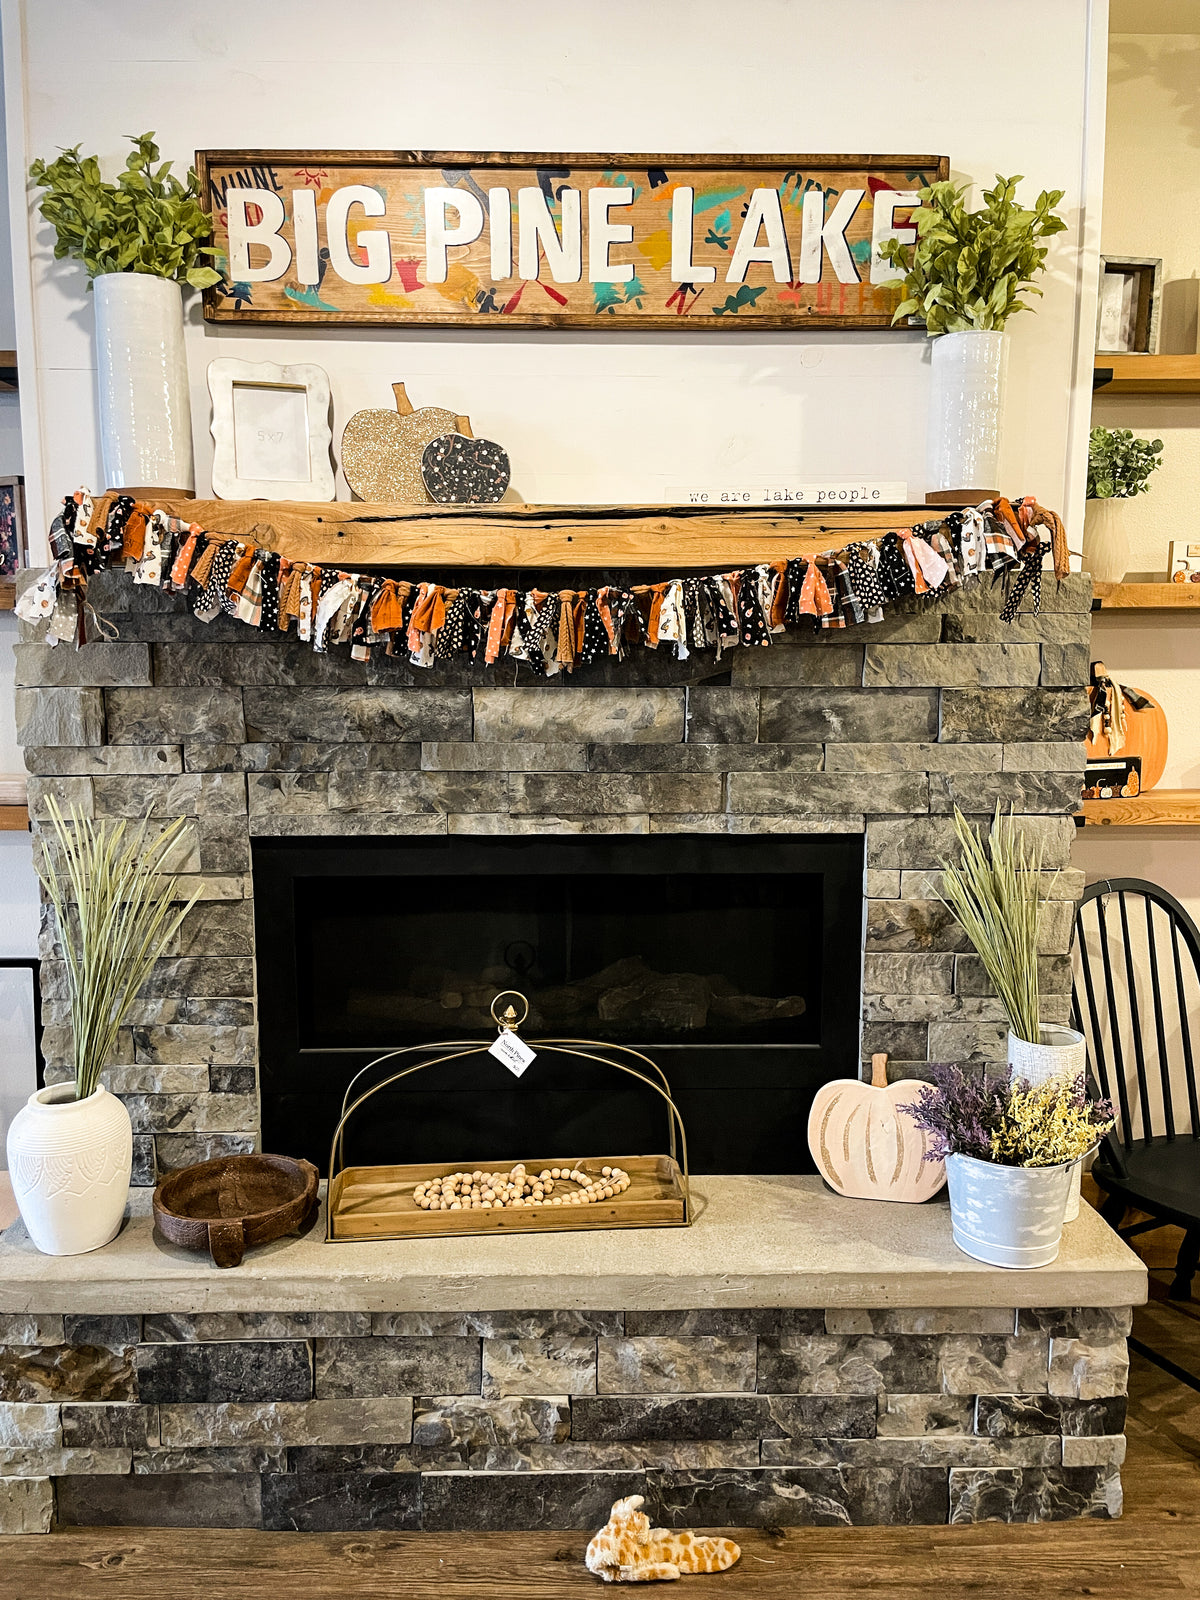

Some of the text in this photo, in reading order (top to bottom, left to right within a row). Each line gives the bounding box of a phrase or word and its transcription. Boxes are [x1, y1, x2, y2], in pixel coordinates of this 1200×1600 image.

[210, 166, 284, 211] MINNE
[226, 184, 391, 285] BIG
[424, 186, 635, 285] PINE
[670, 186, 924, 286] LAKE
[257, 430, 284, 443] 5x7
[688, 486, 881, 503] we are lake people
